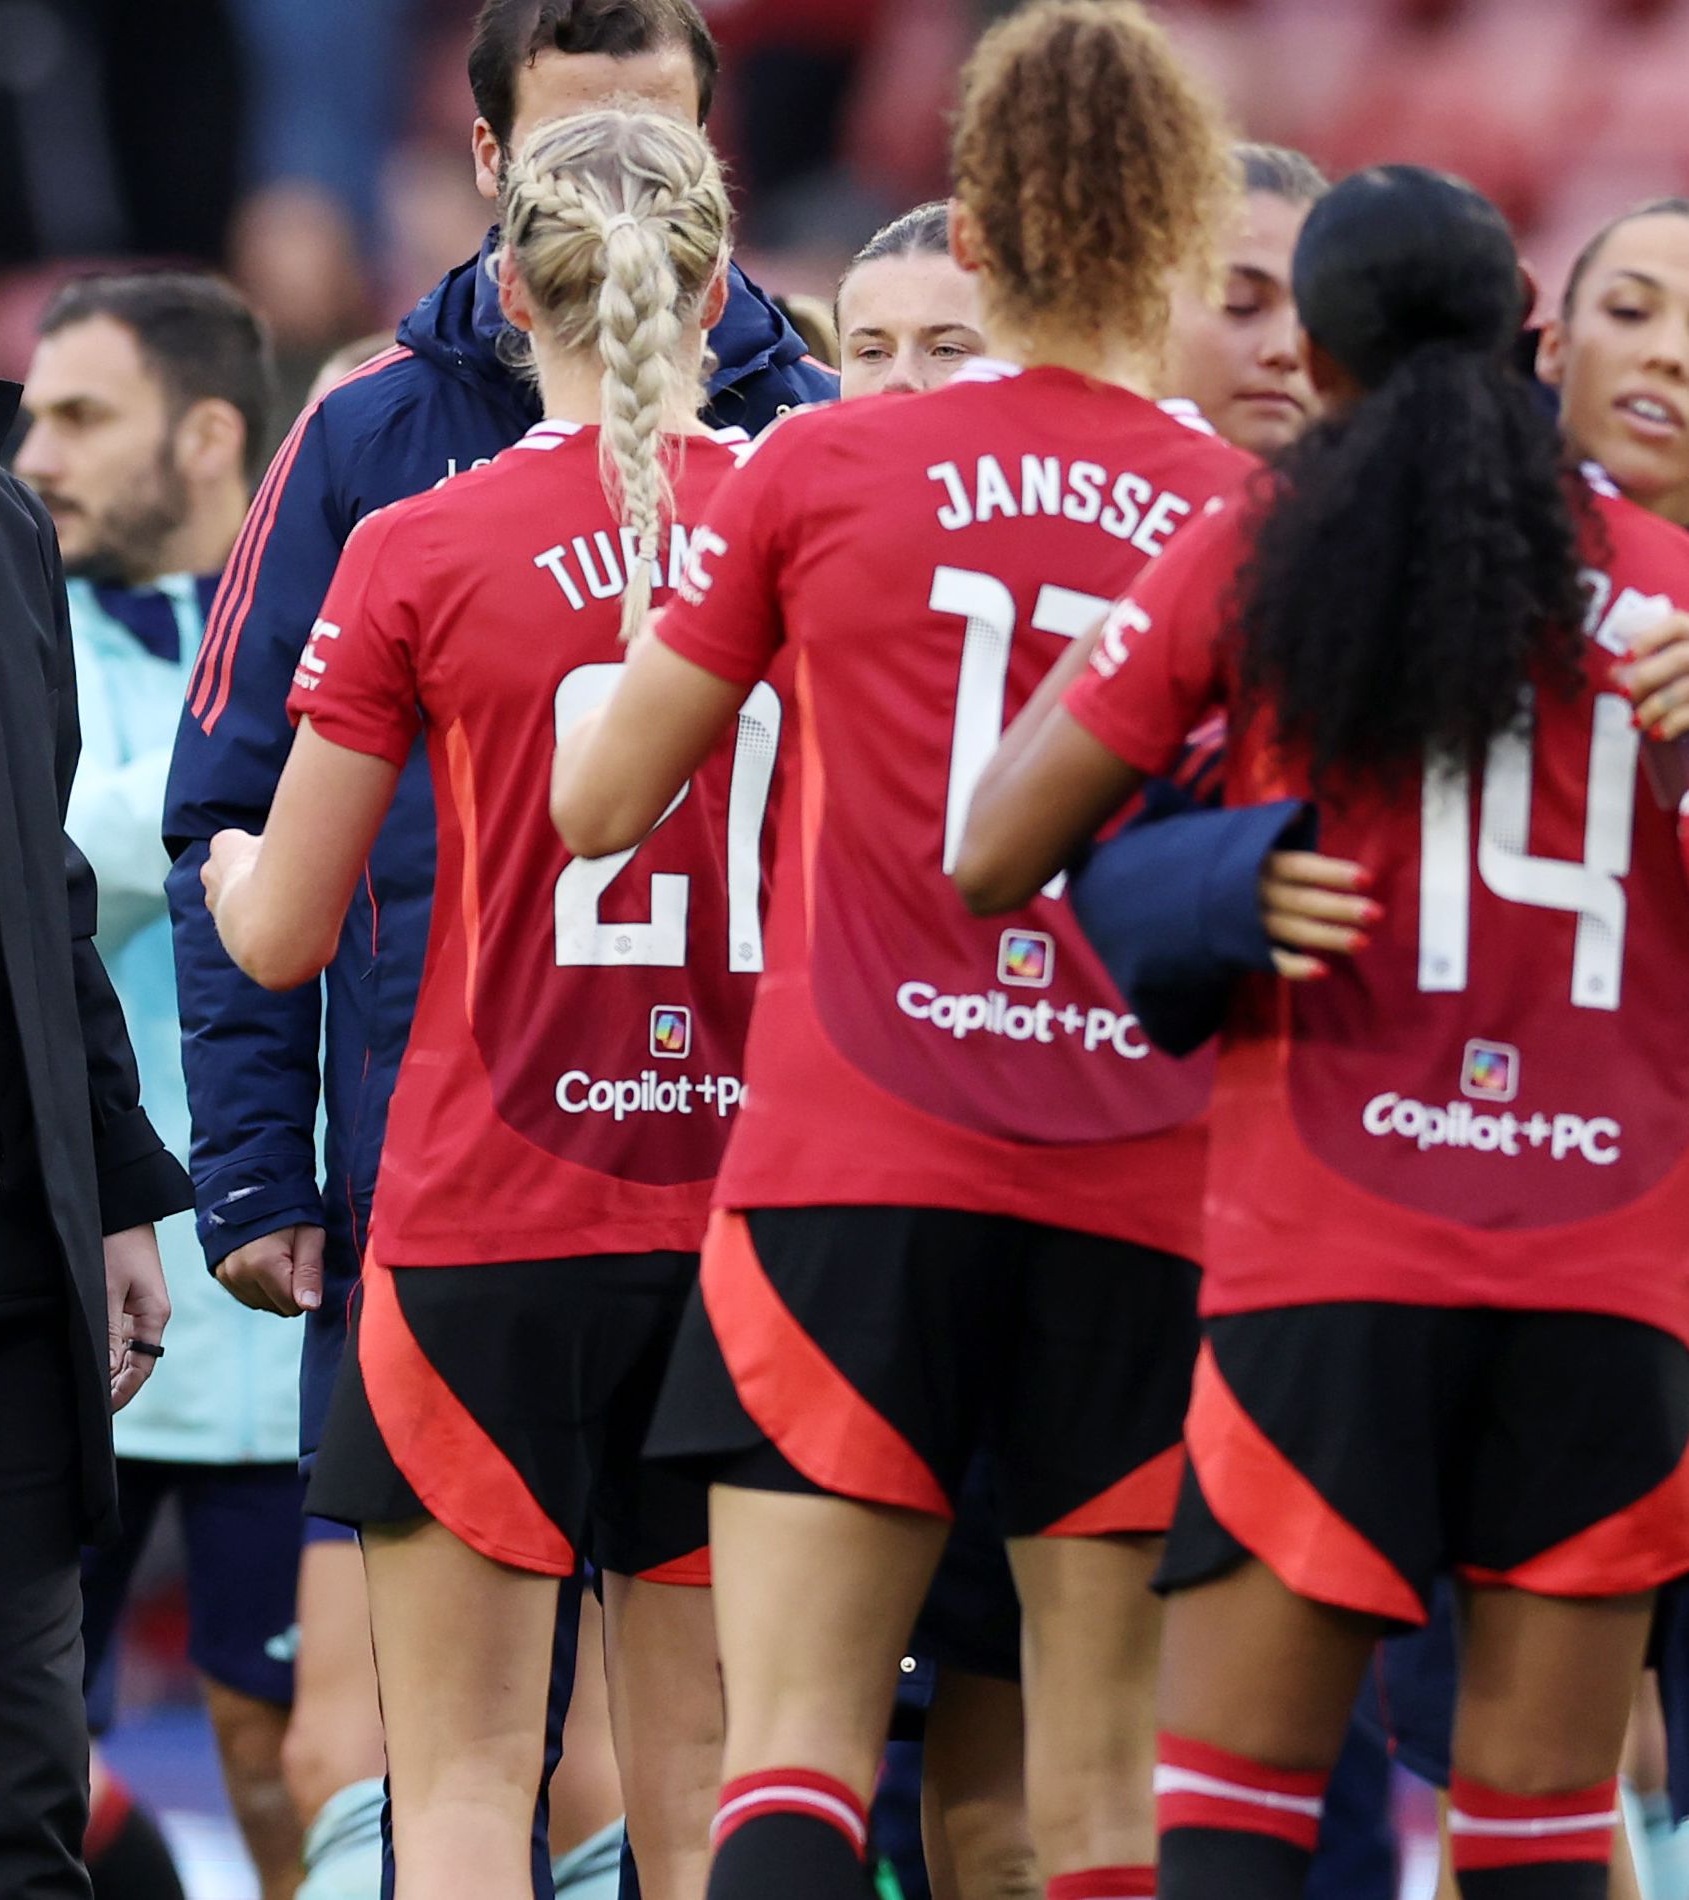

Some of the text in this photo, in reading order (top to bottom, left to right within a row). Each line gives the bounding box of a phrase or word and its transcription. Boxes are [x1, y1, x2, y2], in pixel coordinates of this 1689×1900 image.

[927, 453, 1189, 557] JANSSE
[554, 662, 782, 972] 21
[1417, 690, 1640, 1011] 14
